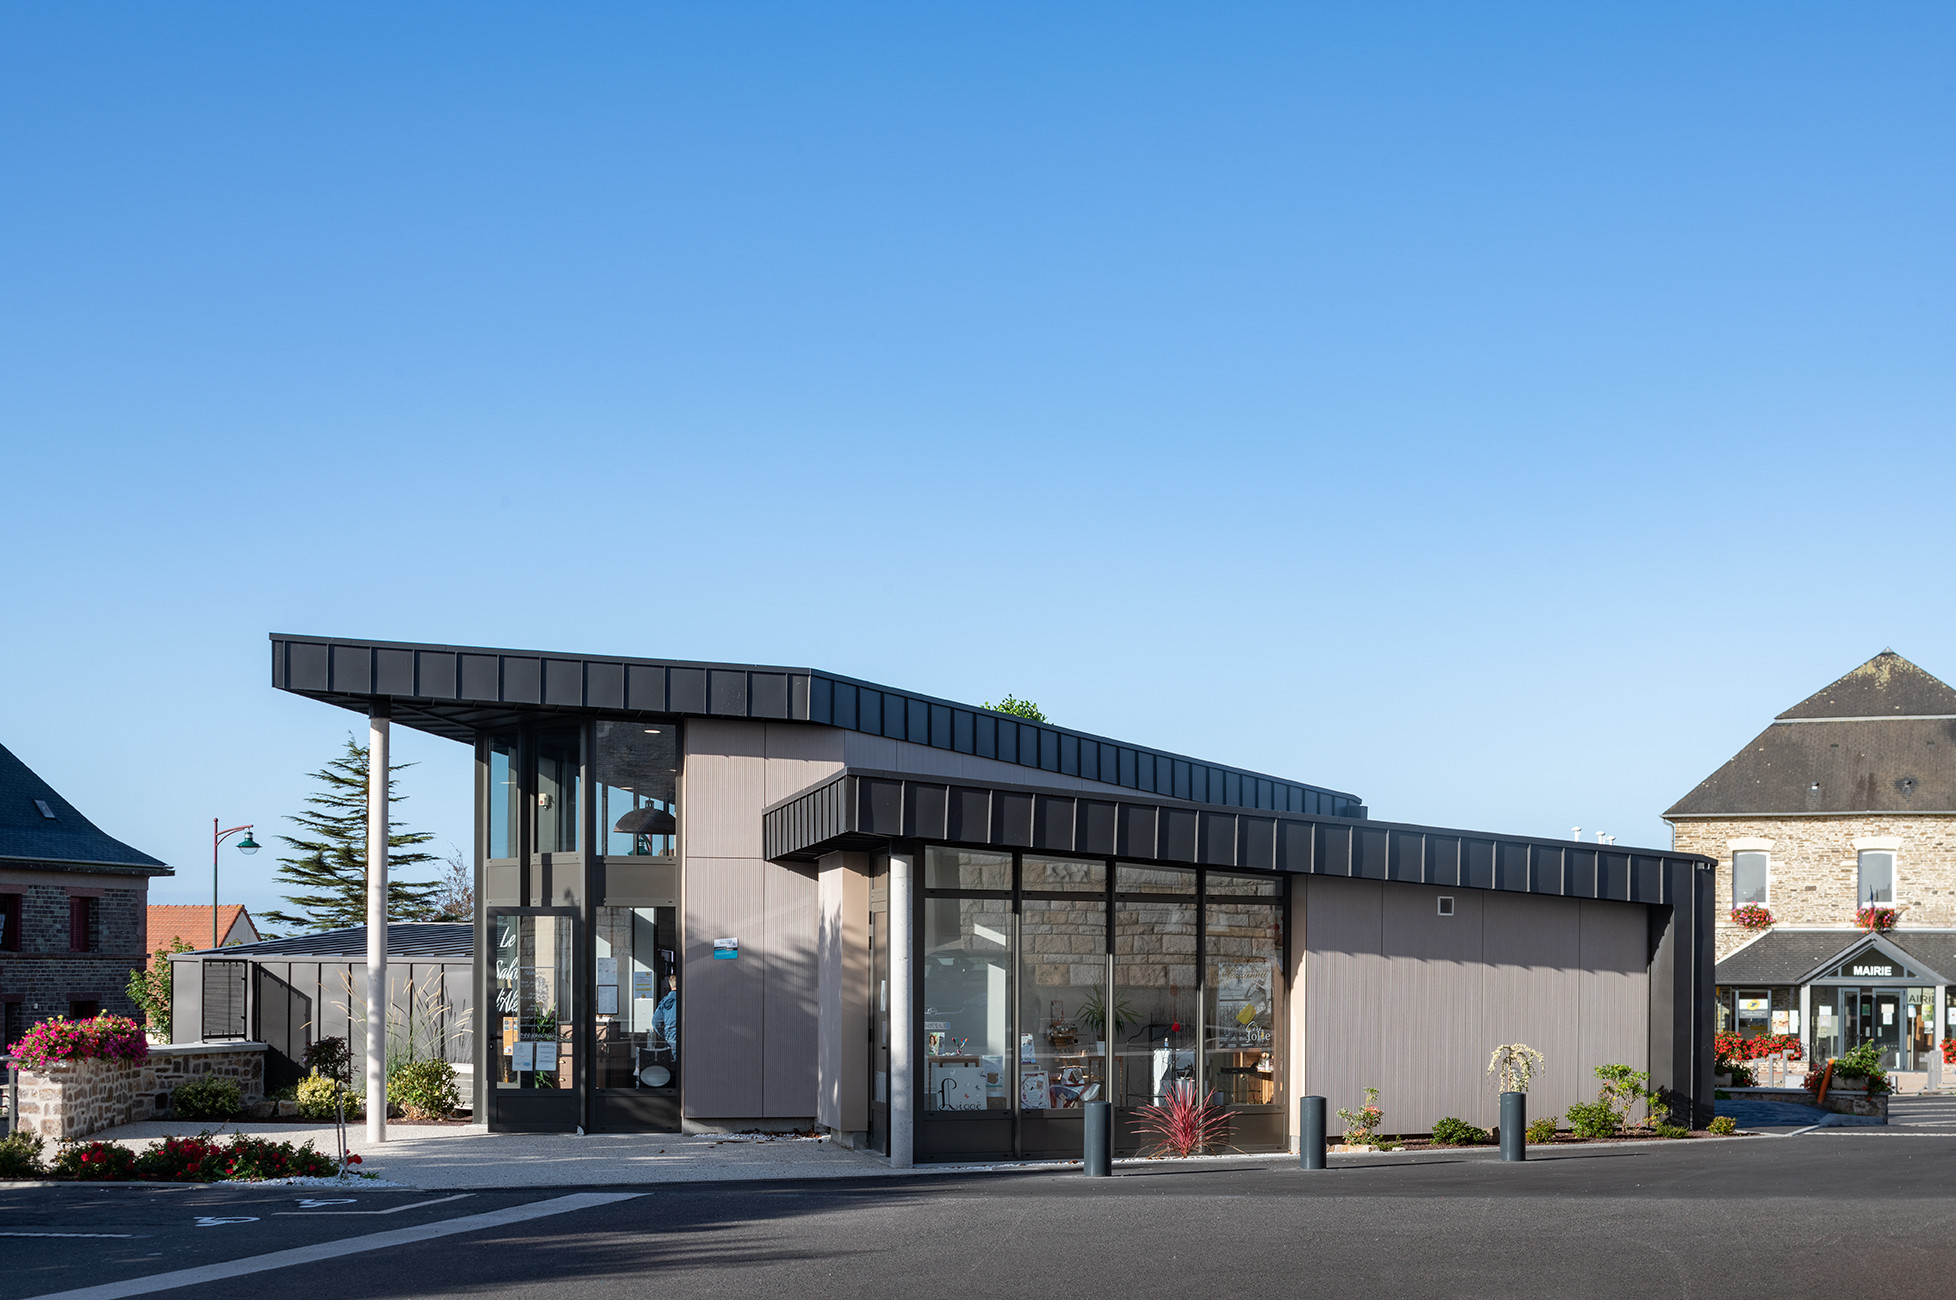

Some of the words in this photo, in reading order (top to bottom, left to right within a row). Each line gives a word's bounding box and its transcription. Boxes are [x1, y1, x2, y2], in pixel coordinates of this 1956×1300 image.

[500, 926, 516, 948] Le
[496, 957, 518, 980] Salo
[1853, 966, 1892, 976] MAIRIE
